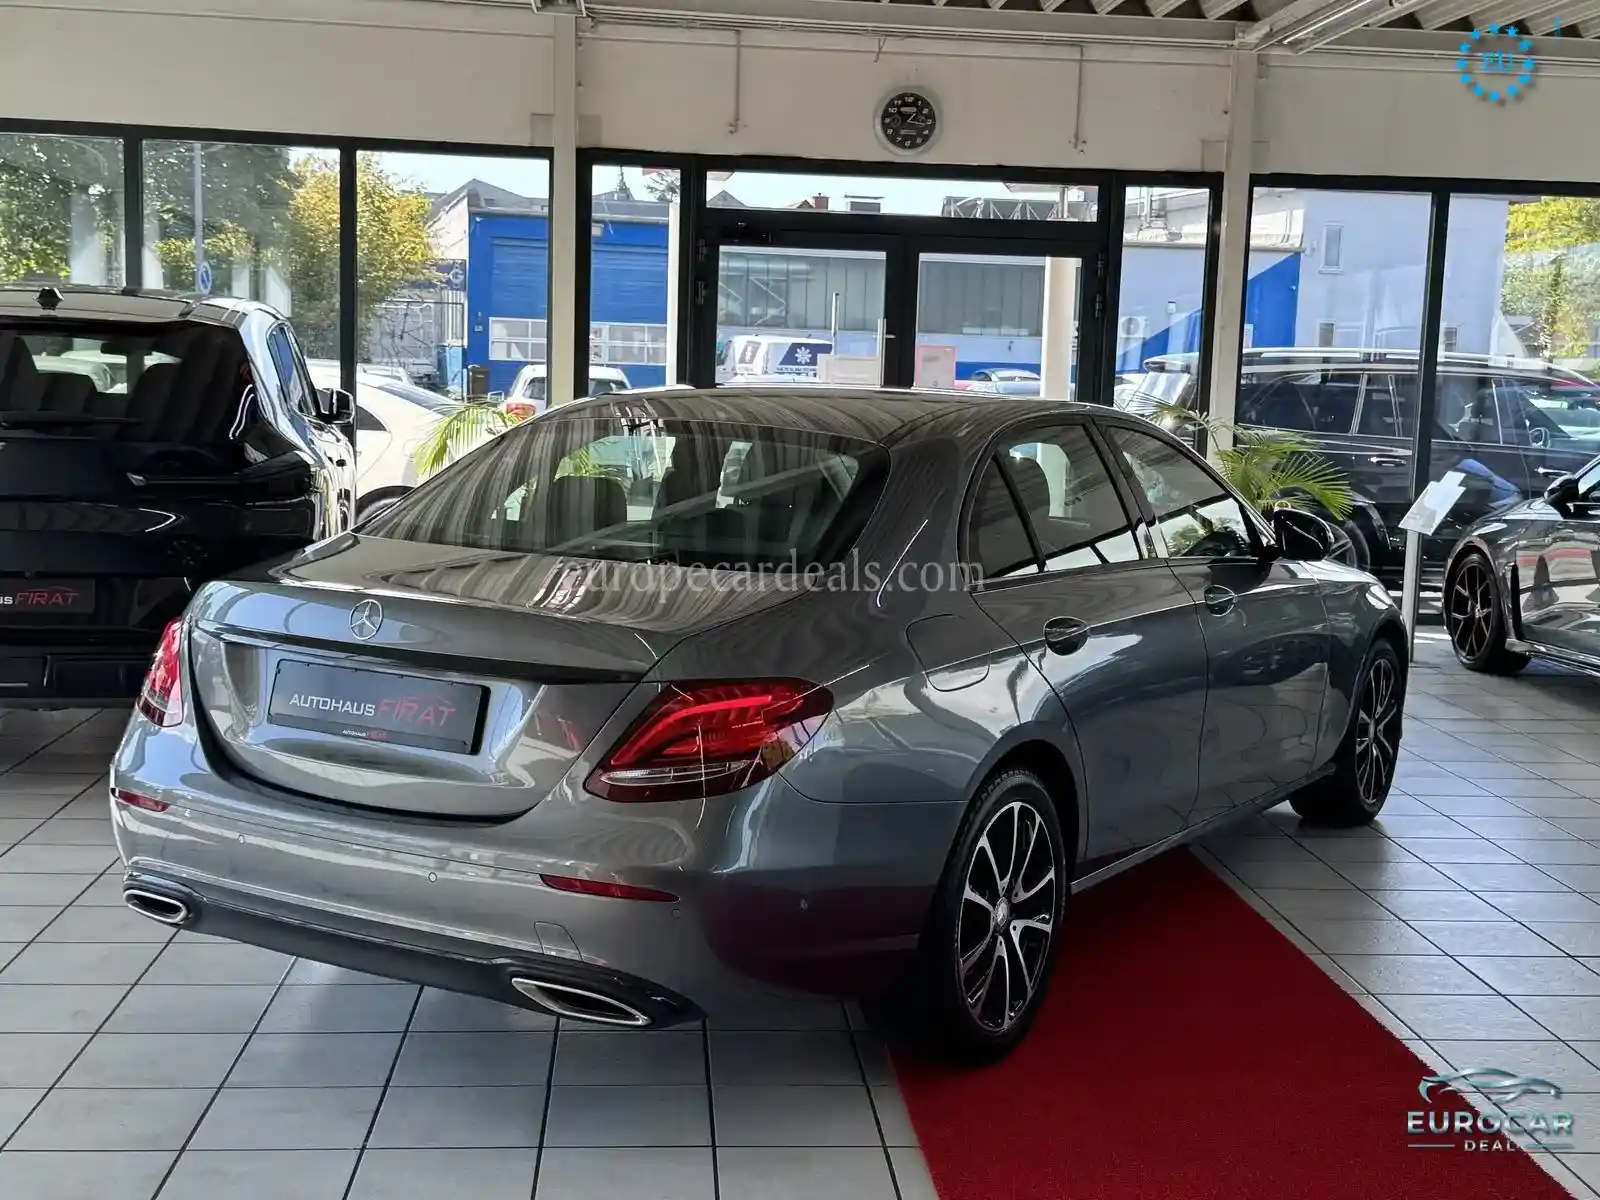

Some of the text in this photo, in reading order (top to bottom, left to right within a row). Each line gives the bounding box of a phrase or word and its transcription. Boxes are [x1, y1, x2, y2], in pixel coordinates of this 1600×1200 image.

[15, 592, 80, 606] FIRAT
[289, 693, 456, 727] AUTOHAUS FIRAT
